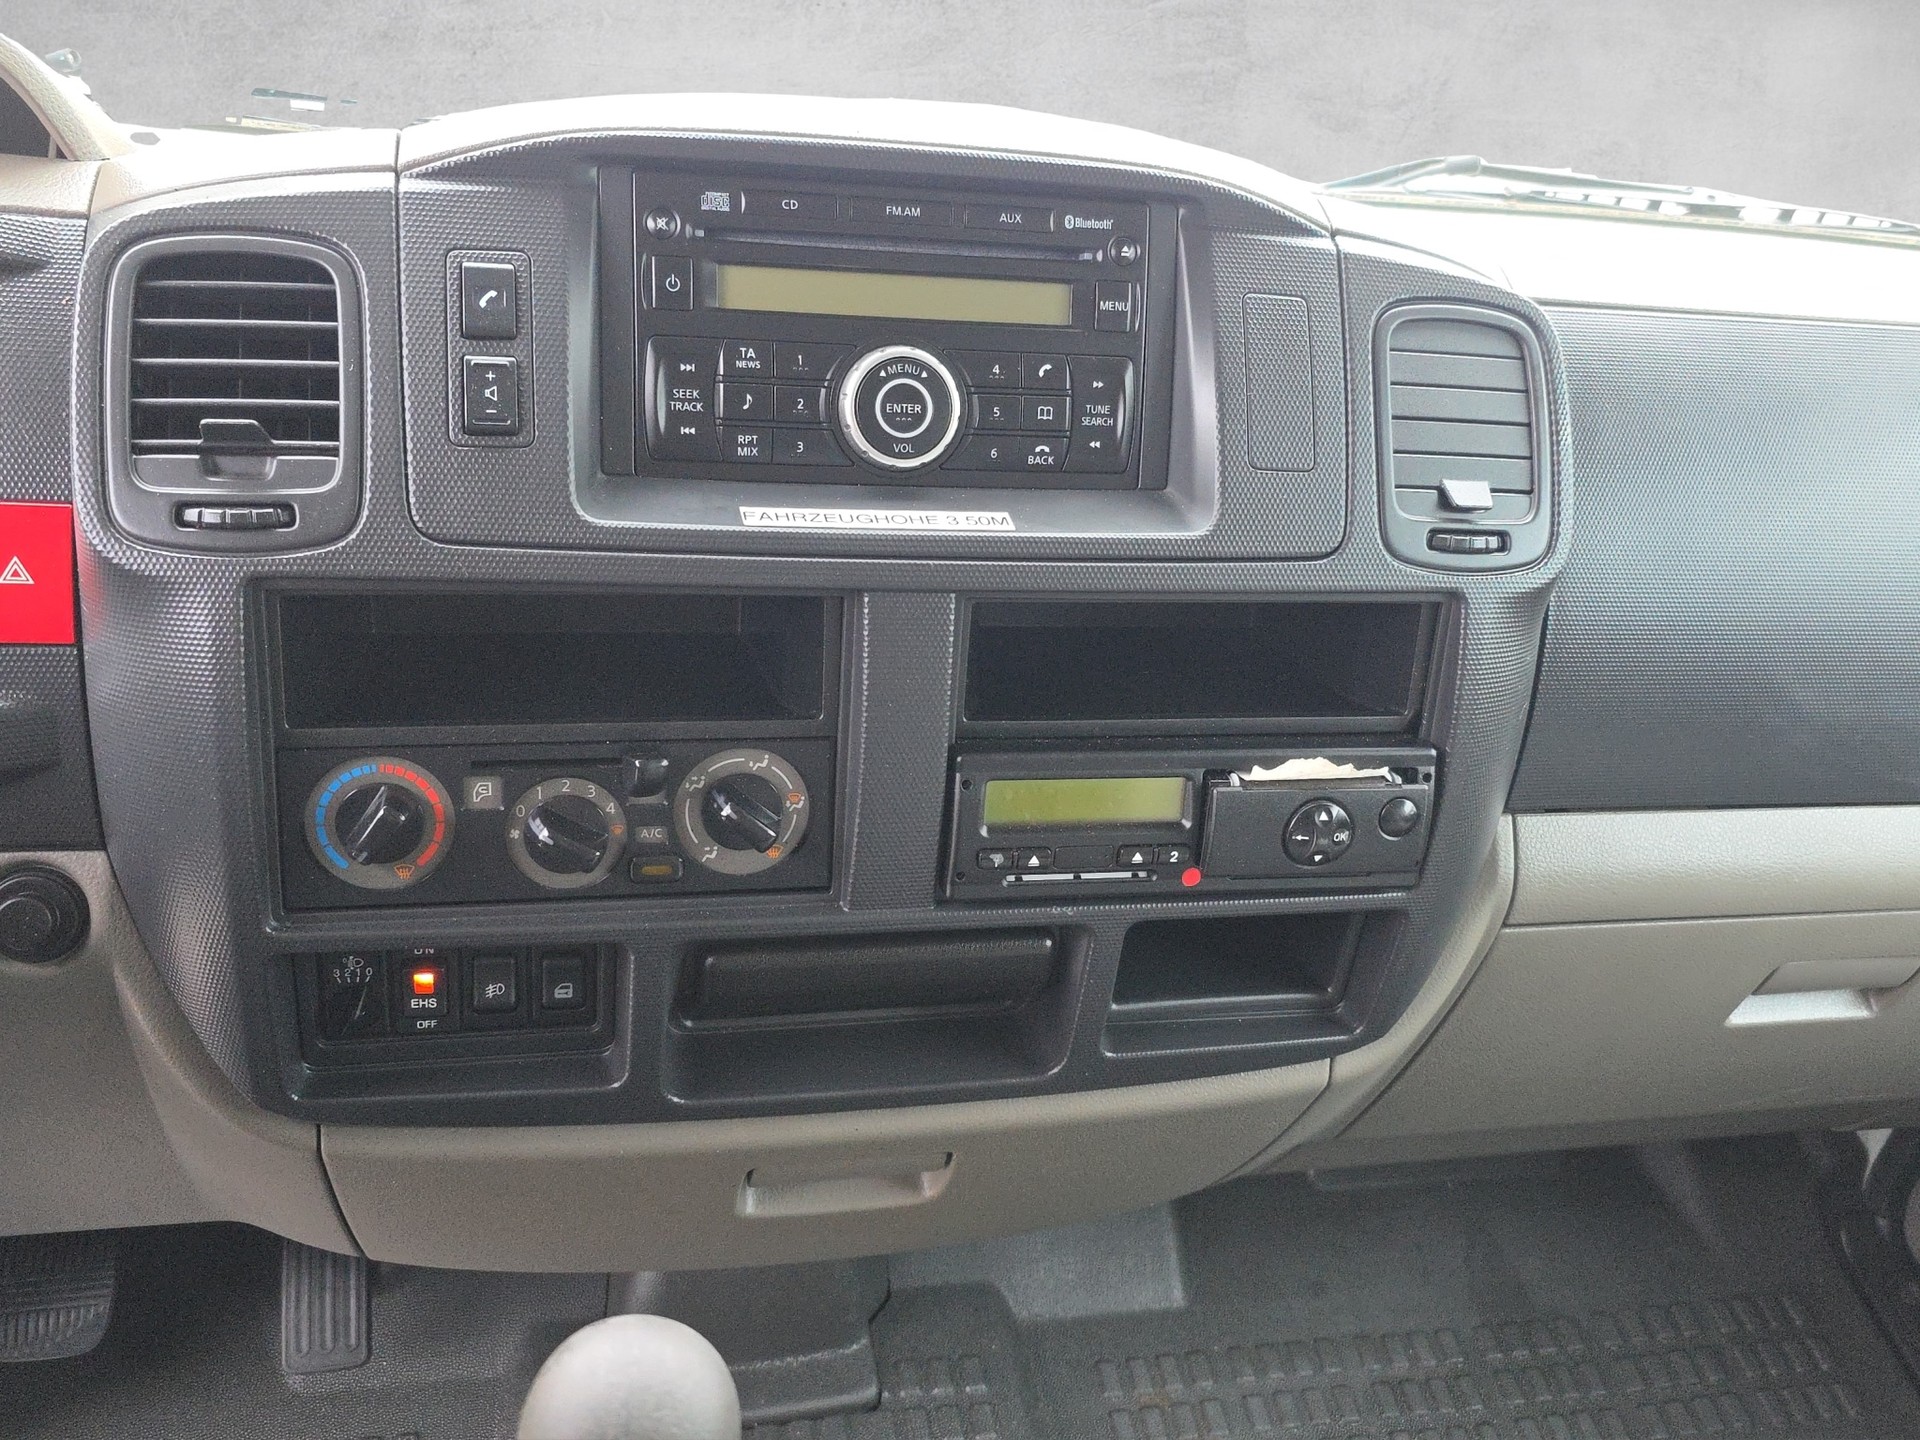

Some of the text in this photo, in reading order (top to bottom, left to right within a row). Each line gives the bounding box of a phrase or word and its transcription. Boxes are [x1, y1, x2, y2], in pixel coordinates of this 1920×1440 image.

[782, 199, 798, 210] CD
[999, 213, 1022, 224] AUX
[1075, 217, 1112, 230] Bluetooth
[1100, 300, 1129, 312] MENU
[740, 347, 756, 359] TA
[736, 360, 761, 369] NEWS
[798, 354, 803, 366] 1
[887, 363, 921, 375] MENU
[992, 364, 1000, 375] 4
[673, 388, 700, 399] SEEK
[669, 402, 704, 412] TRACK
[797, 398, 804, 410] 2
[886, 403, 922, 414] ENTER
[1085, 404, 1111, 415] TUNE
[993, 407, 1000, 418] 5
[1081, 417, 1114, 427] SEARCH
[737, 435, 758, 445] RPT
[737, 447, 758, 457] MIX
[796, 442, 804, 453] 3
[893, 443, 915, 453] VOL
[990, 448, 998, 459] 6
[1027, 455, 1054, 465] BACK
[516, 780, 616, 818] 0 1 2 3 4
[641, 828, 663, 838] A/C
[1333, 832, 1347, 842] OK
[1169, 851, 1179, 863] 2
[333, 967, 373, 978] 3 2 1 0
[411, 998, 437, 1009] EHS
[416, 1020, 438, 1029] OFF
